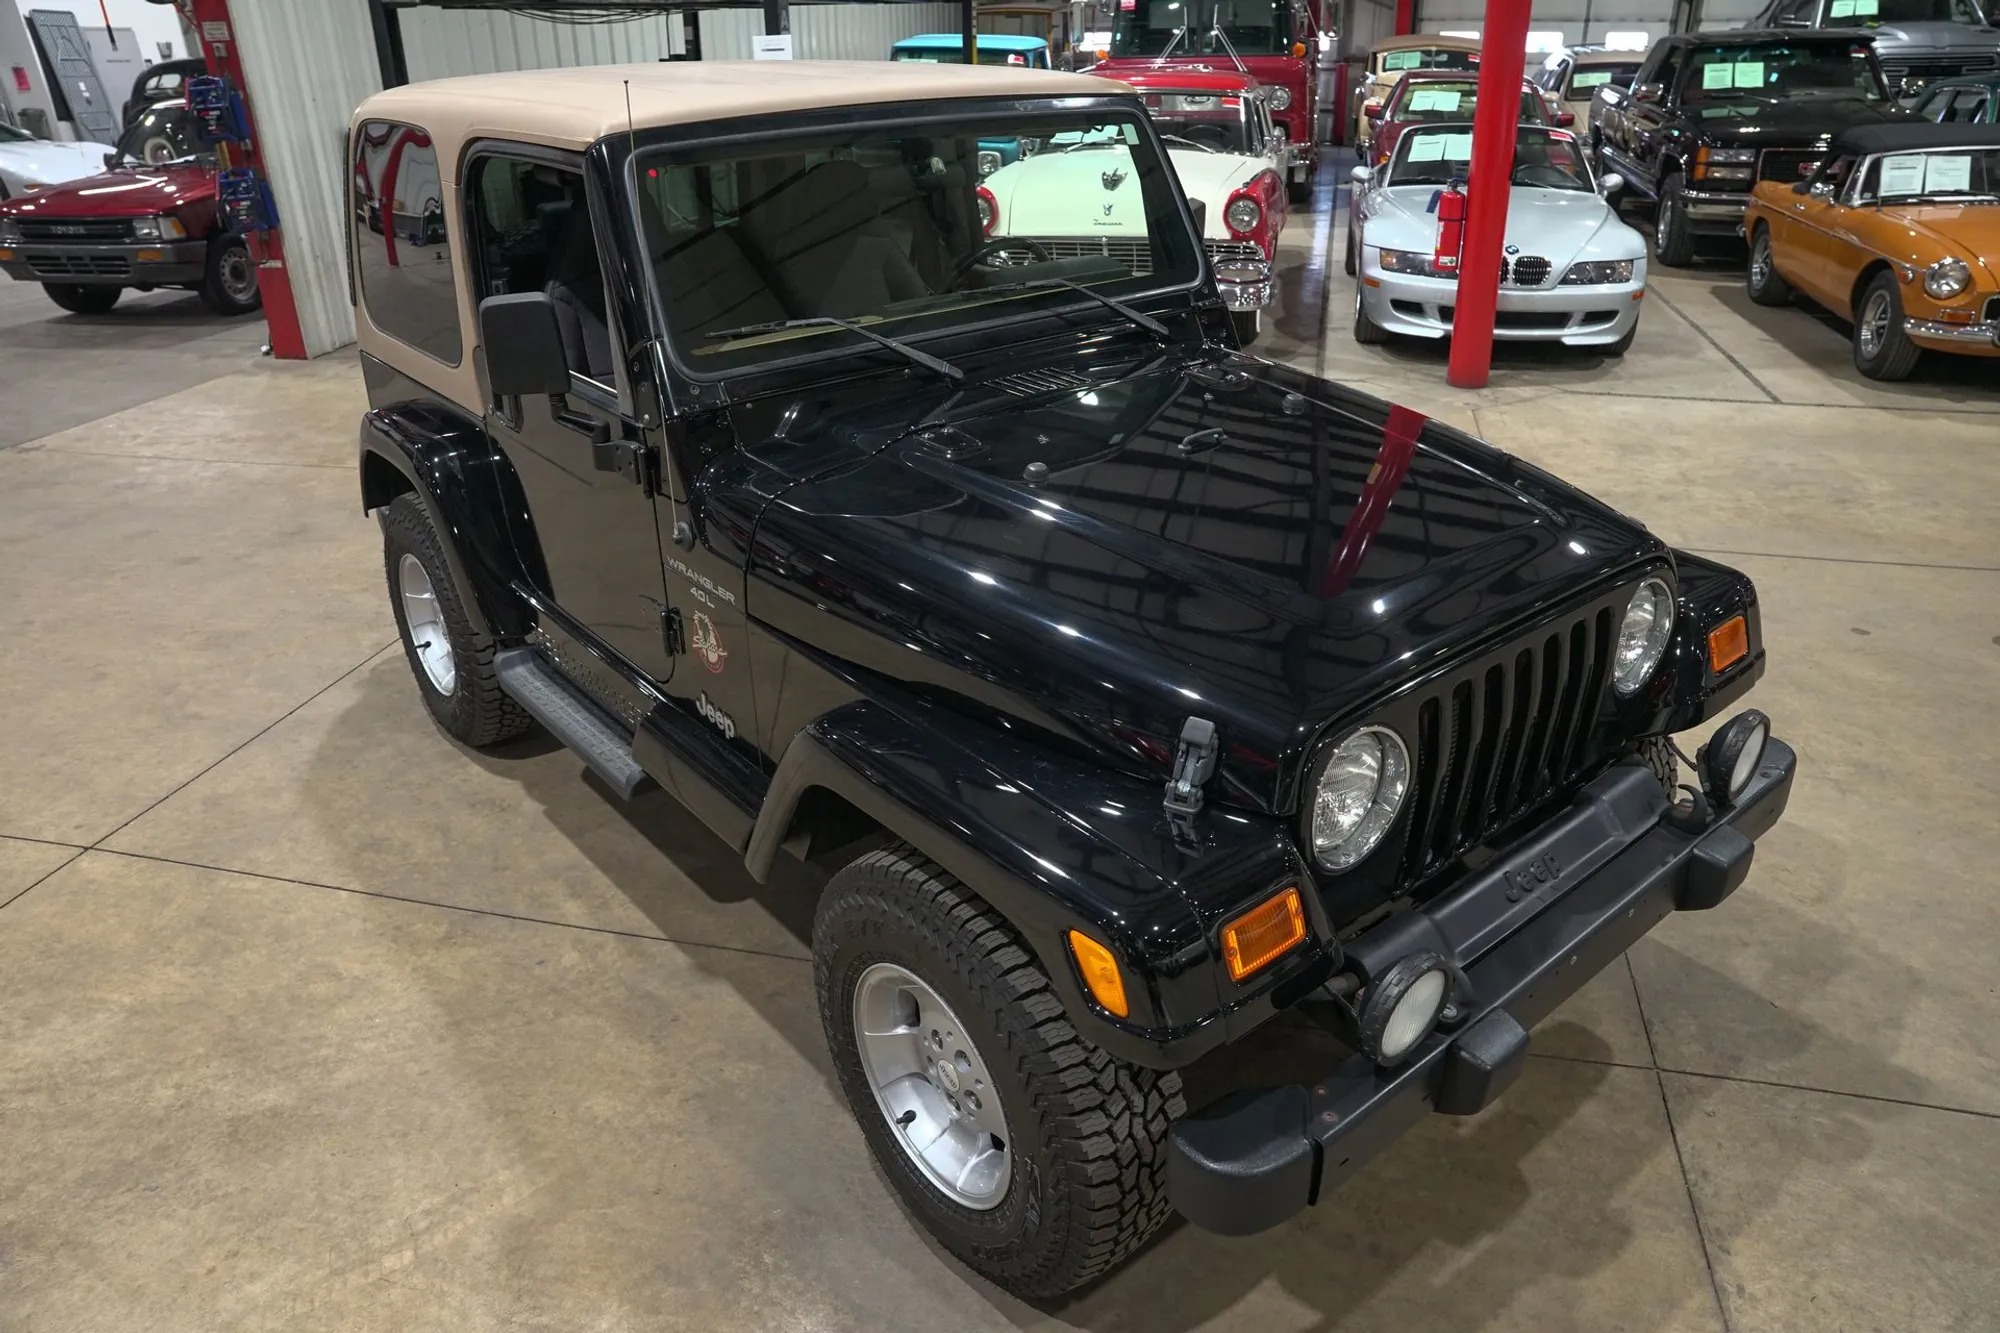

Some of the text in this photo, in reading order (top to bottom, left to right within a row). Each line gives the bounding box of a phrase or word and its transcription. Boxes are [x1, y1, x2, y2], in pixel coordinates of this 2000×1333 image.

[50, 225, 87, 235] TOYOTA
[666, 554, 736, 606] WRANGLER
[695, 692, 736, 740] Jeep
[1502, 850, 1561, 904] Jeep
